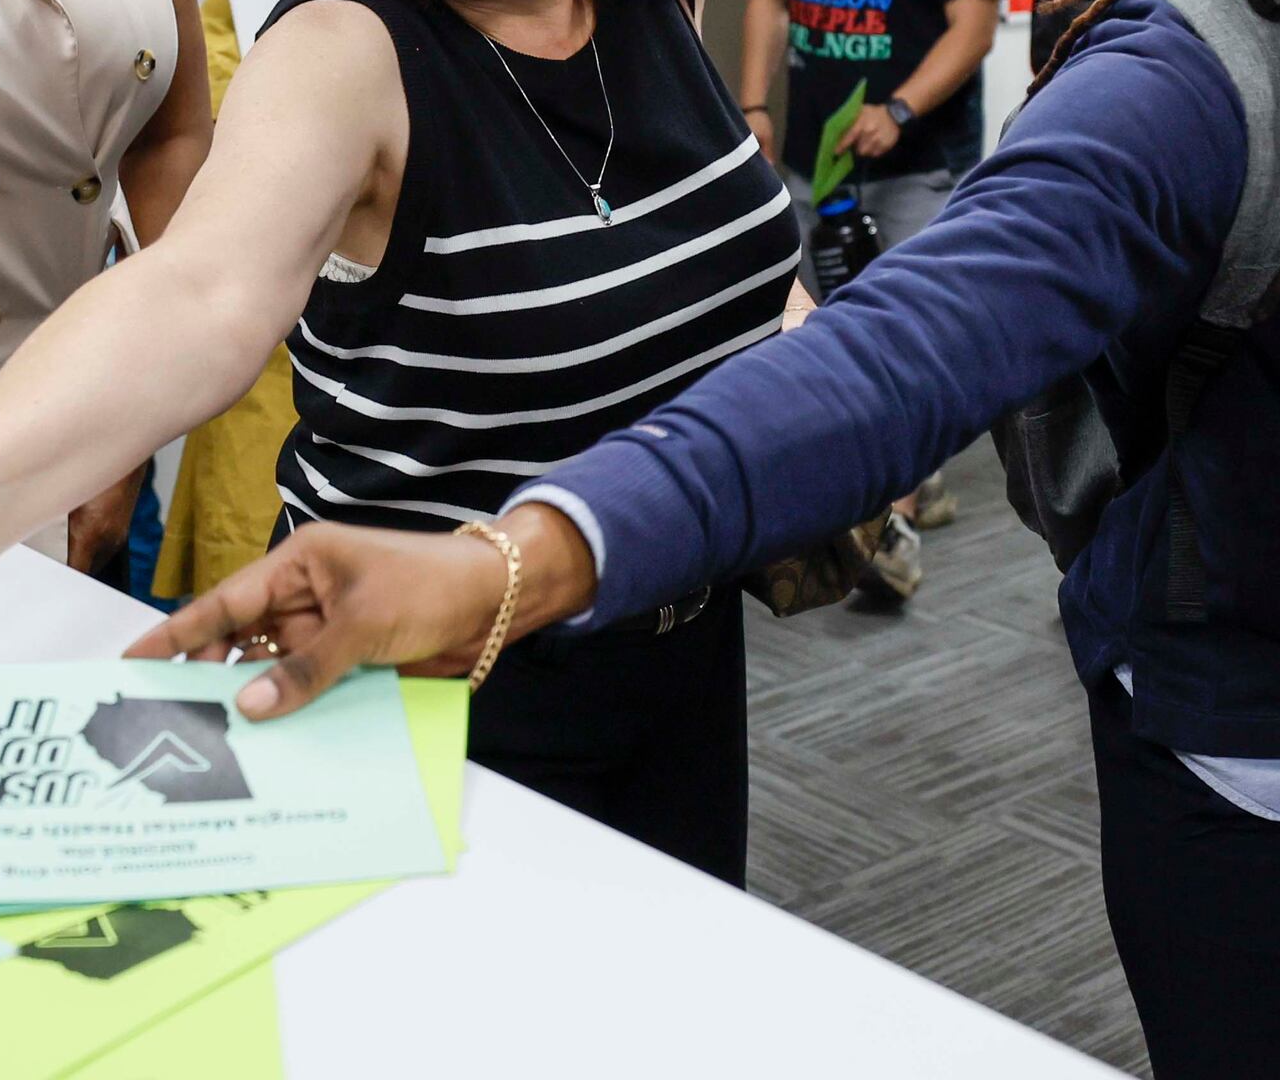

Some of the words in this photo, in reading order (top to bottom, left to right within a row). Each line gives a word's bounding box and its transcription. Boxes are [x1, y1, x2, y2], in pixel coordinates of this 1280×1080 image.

[789, 23, 892, 60] RNGE
[142, 816, 237, 833] Mental
[245, 808, 348, 827] Georgia
[43, 820, 136, 838] Health
